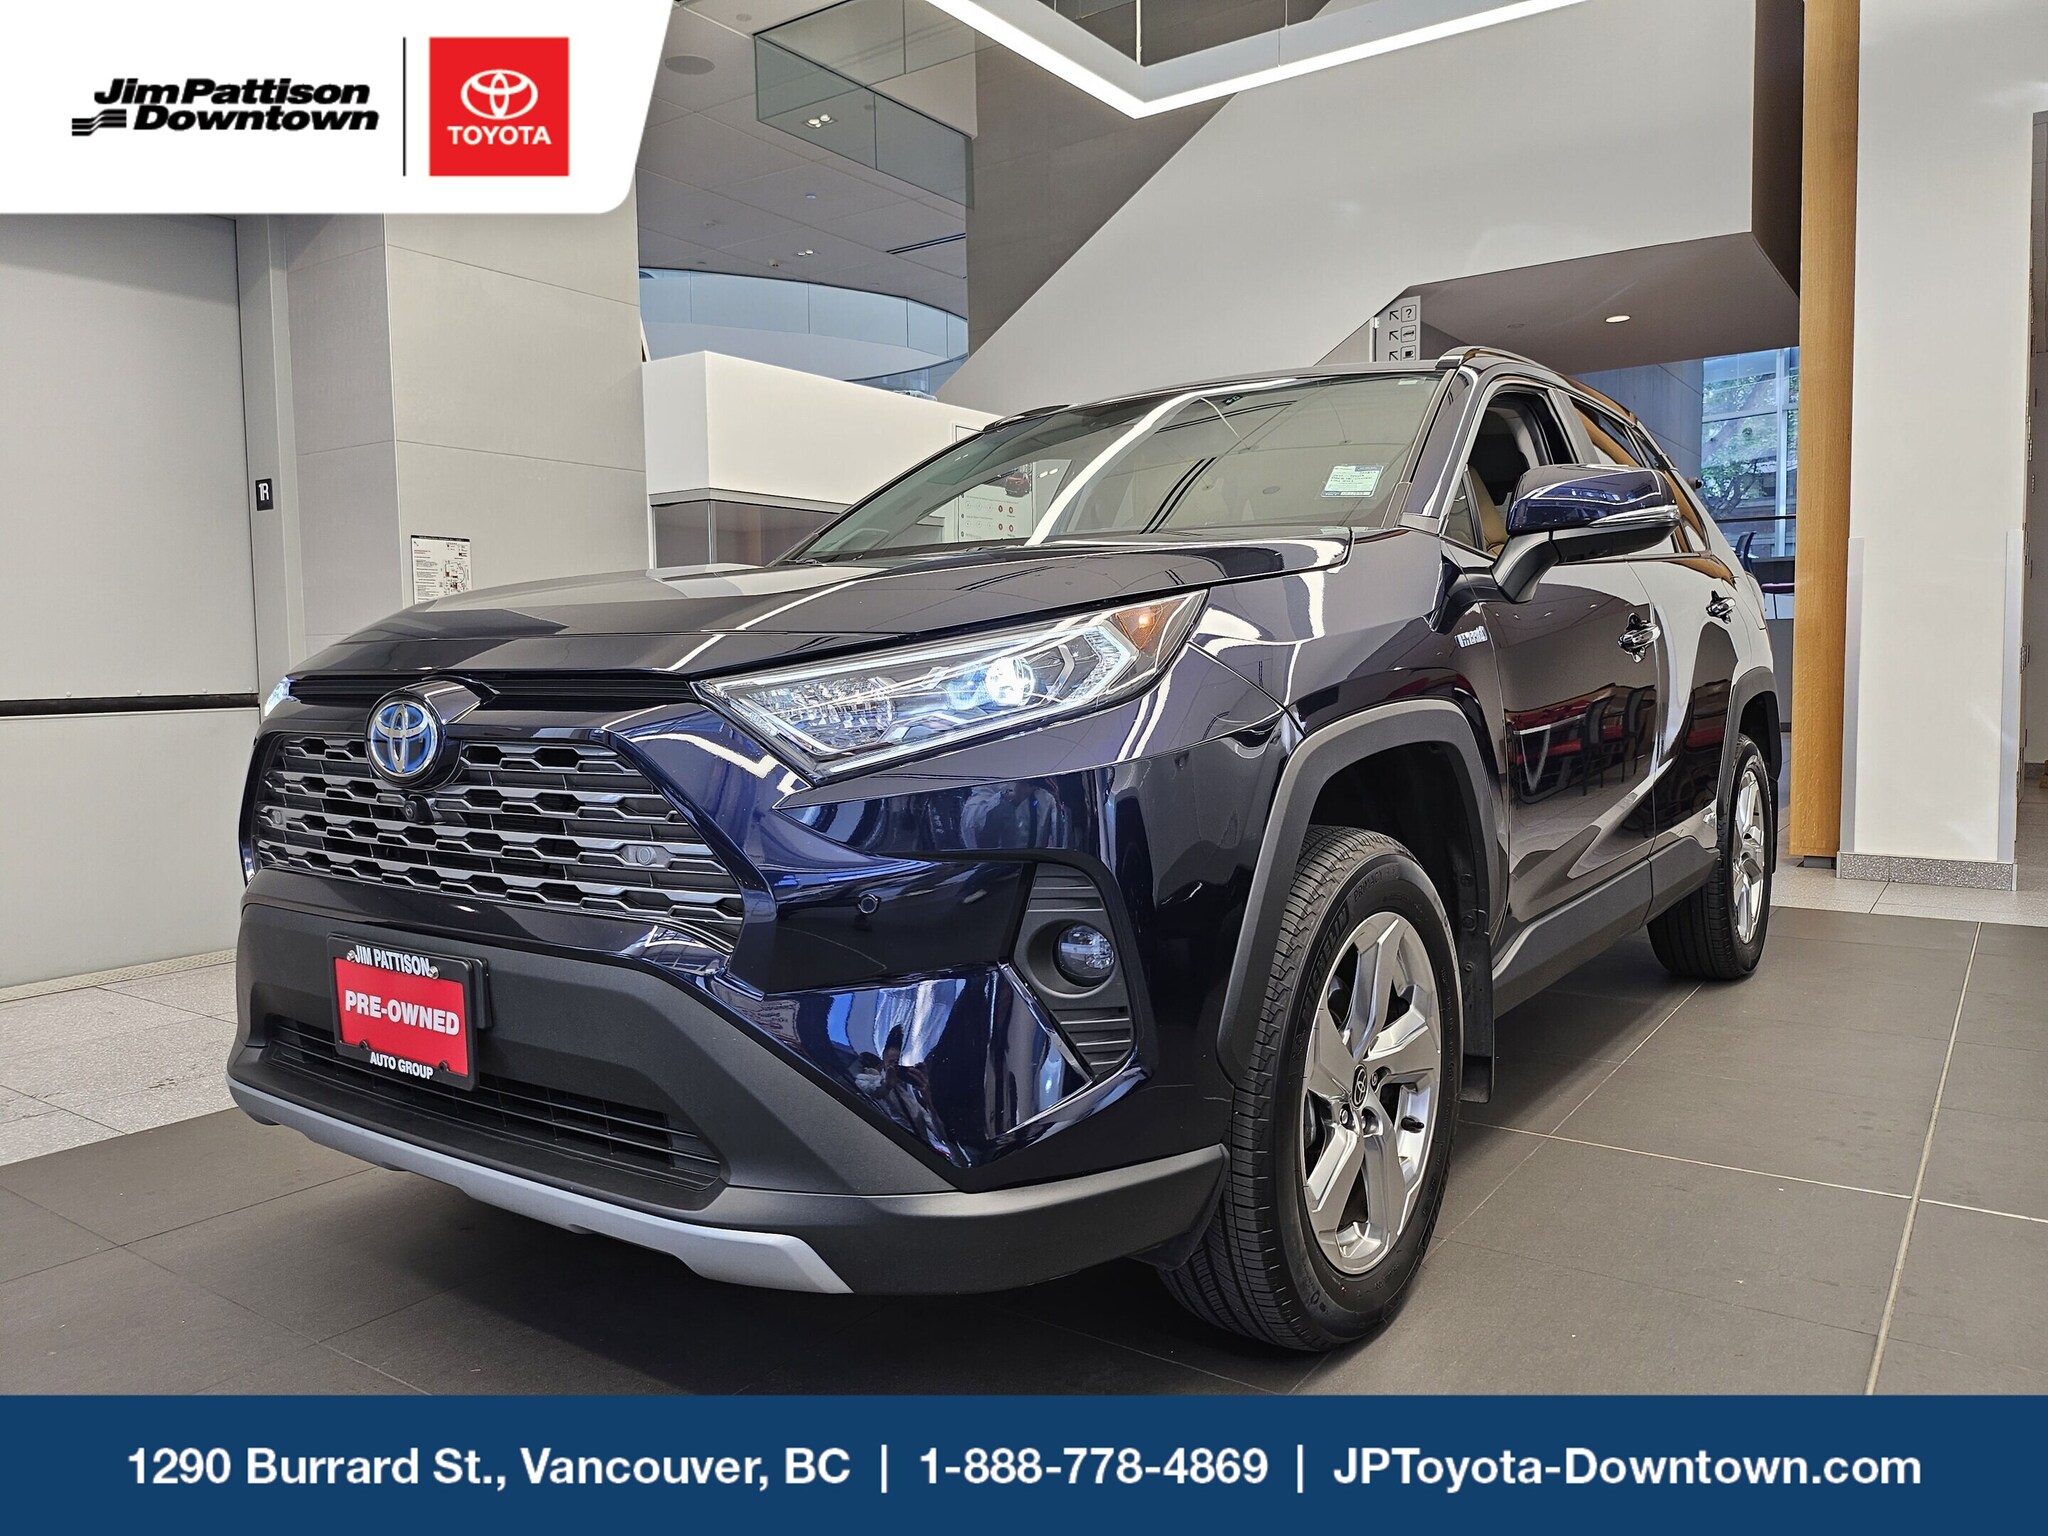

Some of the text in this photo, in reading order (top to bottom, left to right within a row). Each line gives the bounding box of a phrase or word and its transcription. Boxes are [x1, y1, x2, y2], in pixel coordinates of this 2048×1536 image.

[354, 944, 430, 977] JIM PATTISON
[345, 989, 460, 1036] PRE-OWNED
[369, 1051, 434, 1080] AUTO GROUP
